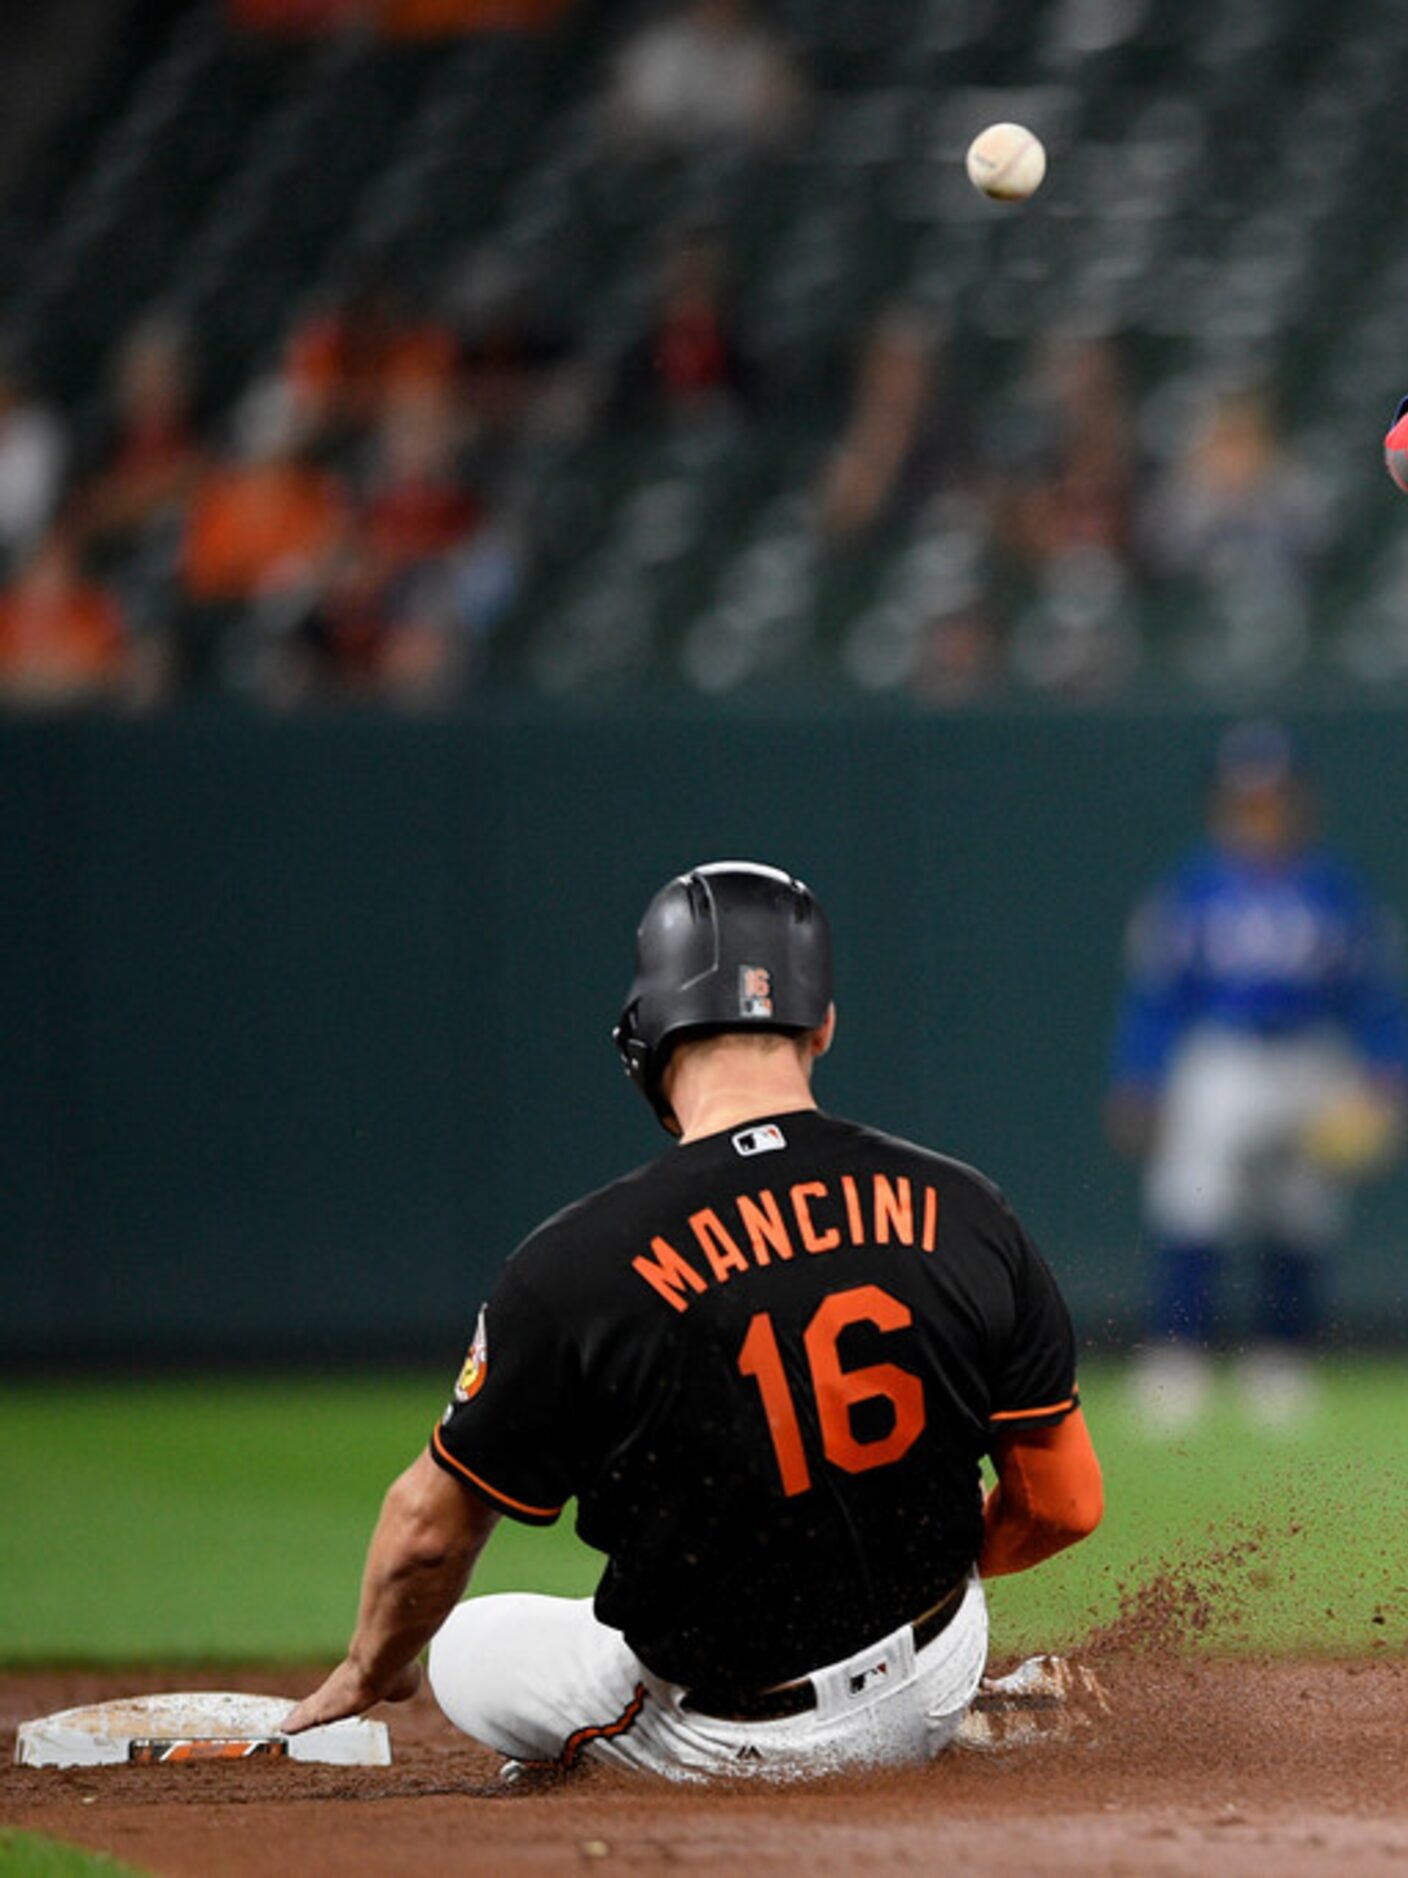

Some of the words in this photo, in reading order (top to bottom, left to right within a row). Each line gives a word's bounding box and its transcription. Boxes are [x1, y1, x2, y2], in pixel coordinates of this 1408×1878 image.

[744, 967, 771, 998] 16
[631, 1173, 937, 1313] MANCINI
[737, 1284, 926, 1497] 16
